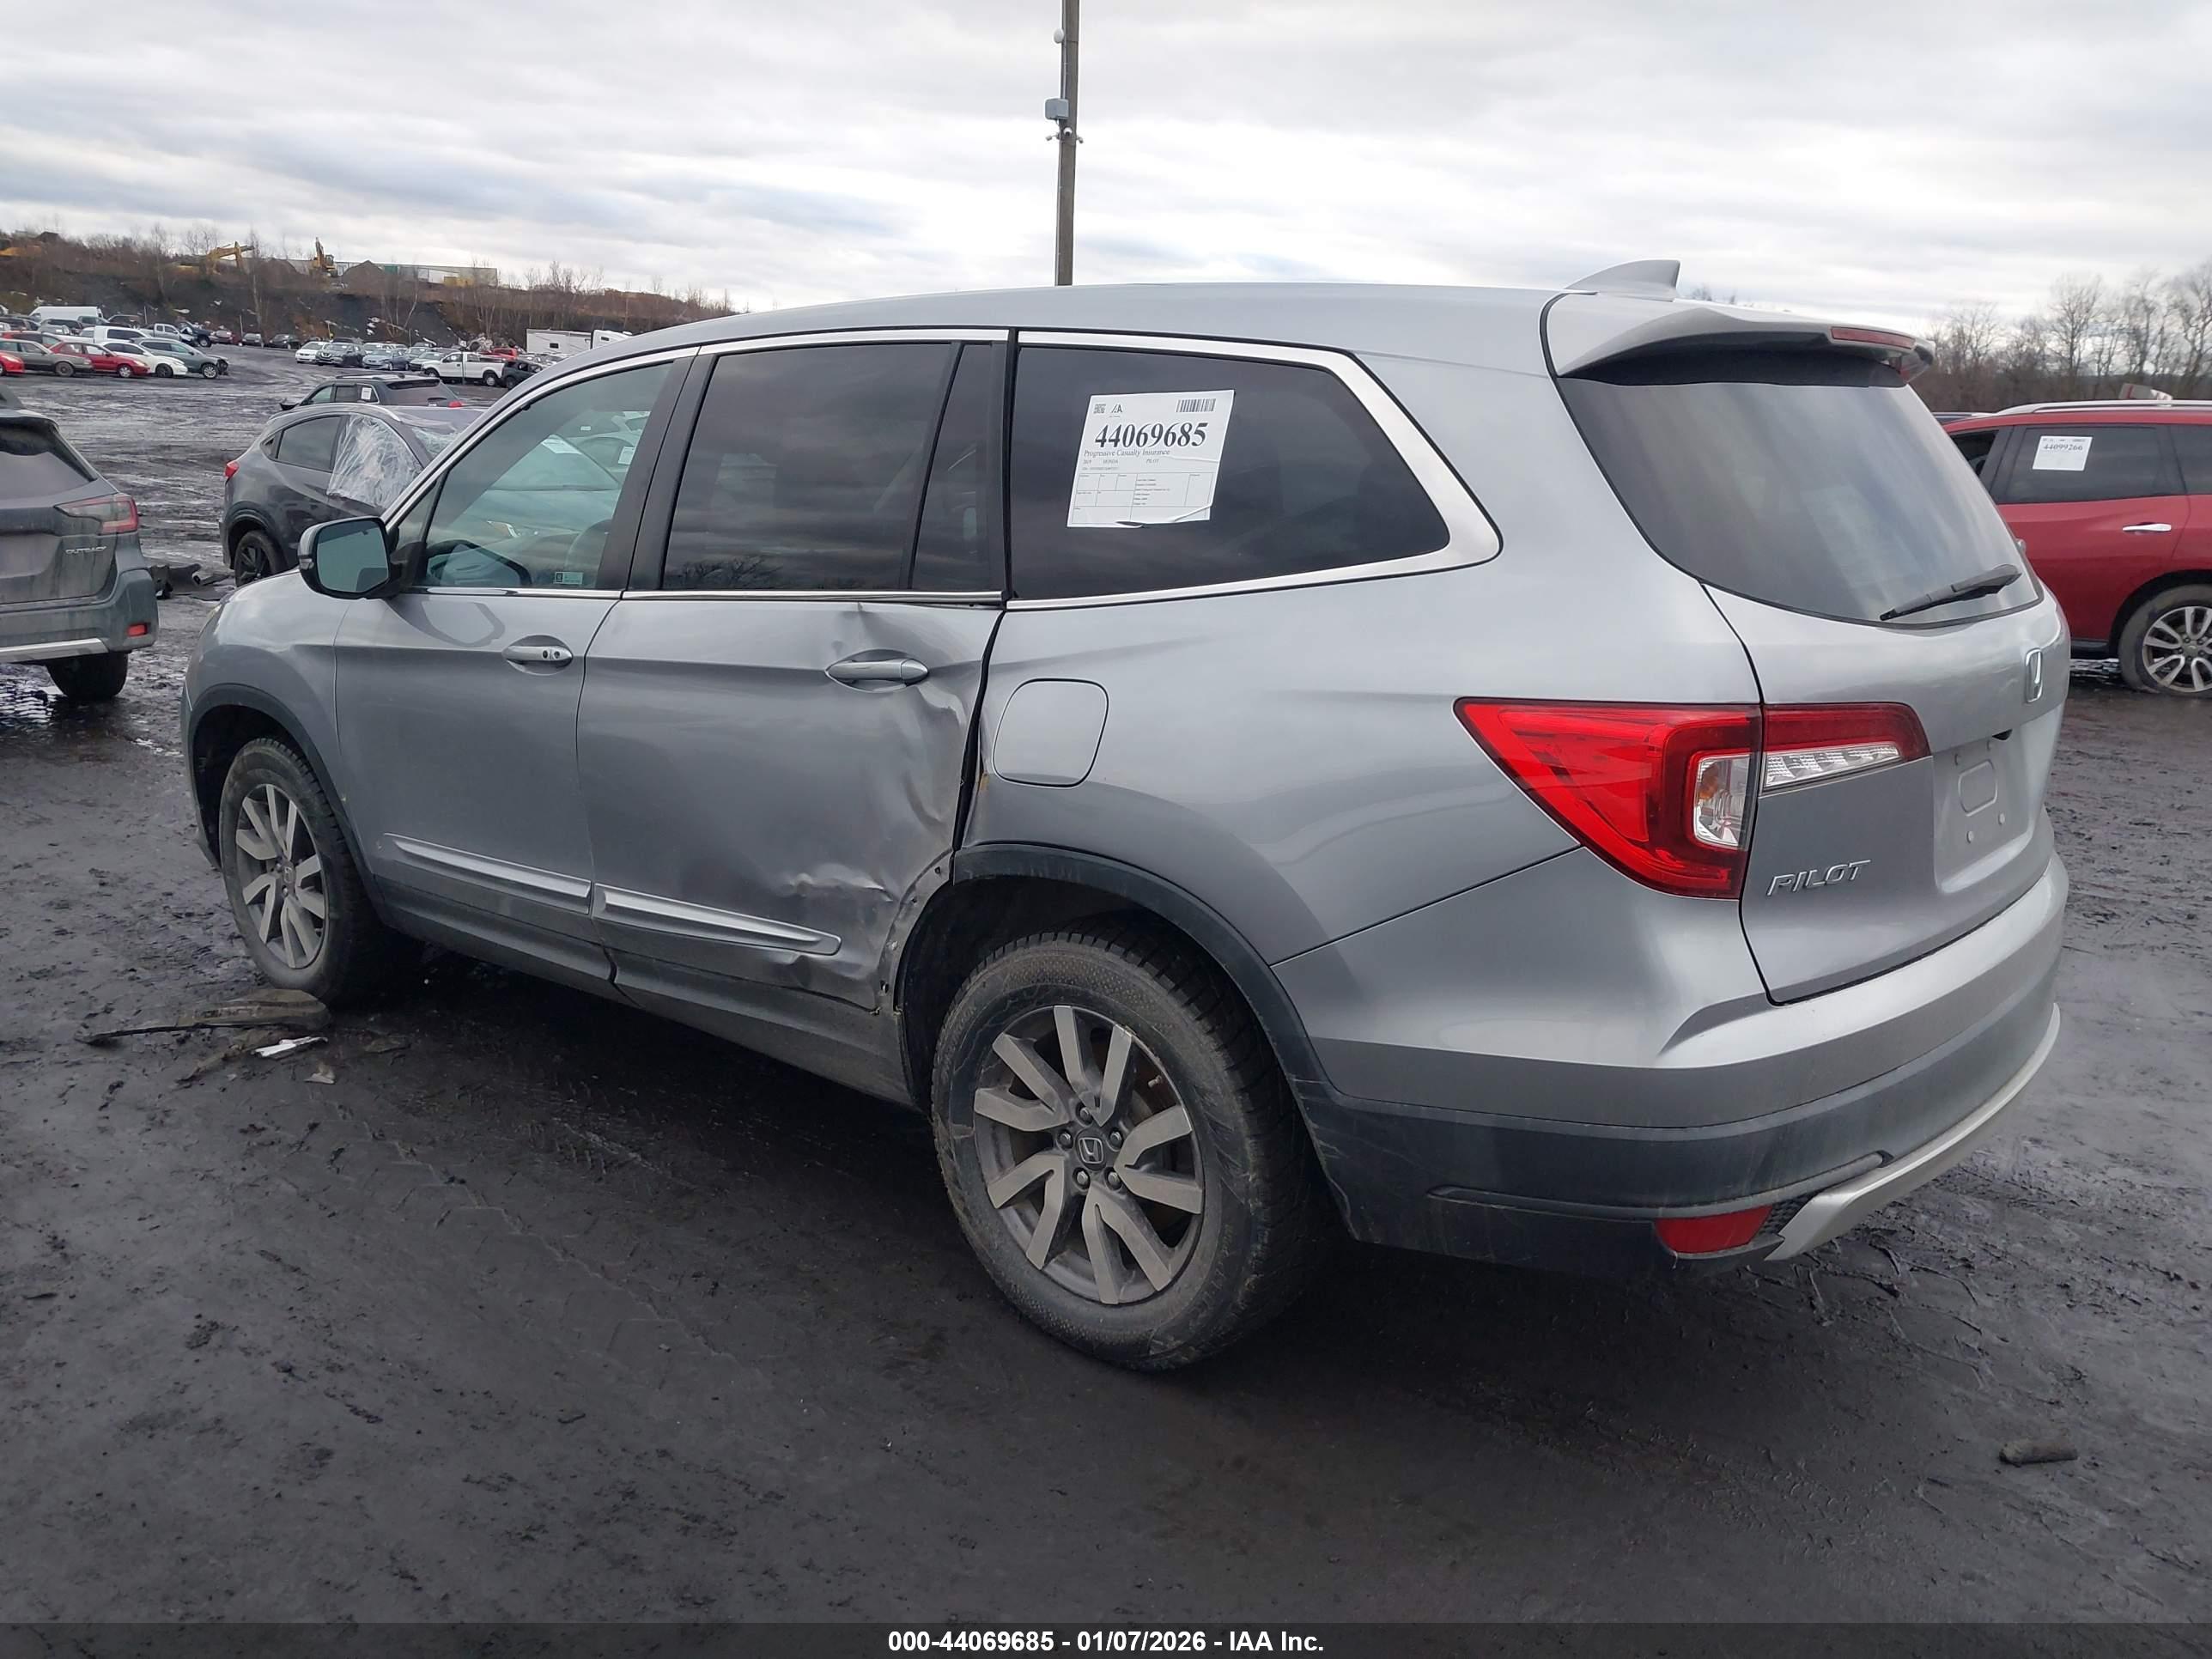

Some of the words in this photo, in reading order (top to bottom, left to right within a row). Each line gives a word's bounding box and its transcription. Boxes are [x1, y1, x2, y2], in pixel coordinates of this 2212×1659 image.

[1095, 422, 1208, 447] 44069685
[1084, 450, 1115, 459] Progressive
[1116, 449, 1140, 458] Casualty
[1766, 860, 1871, 896] PILOT
